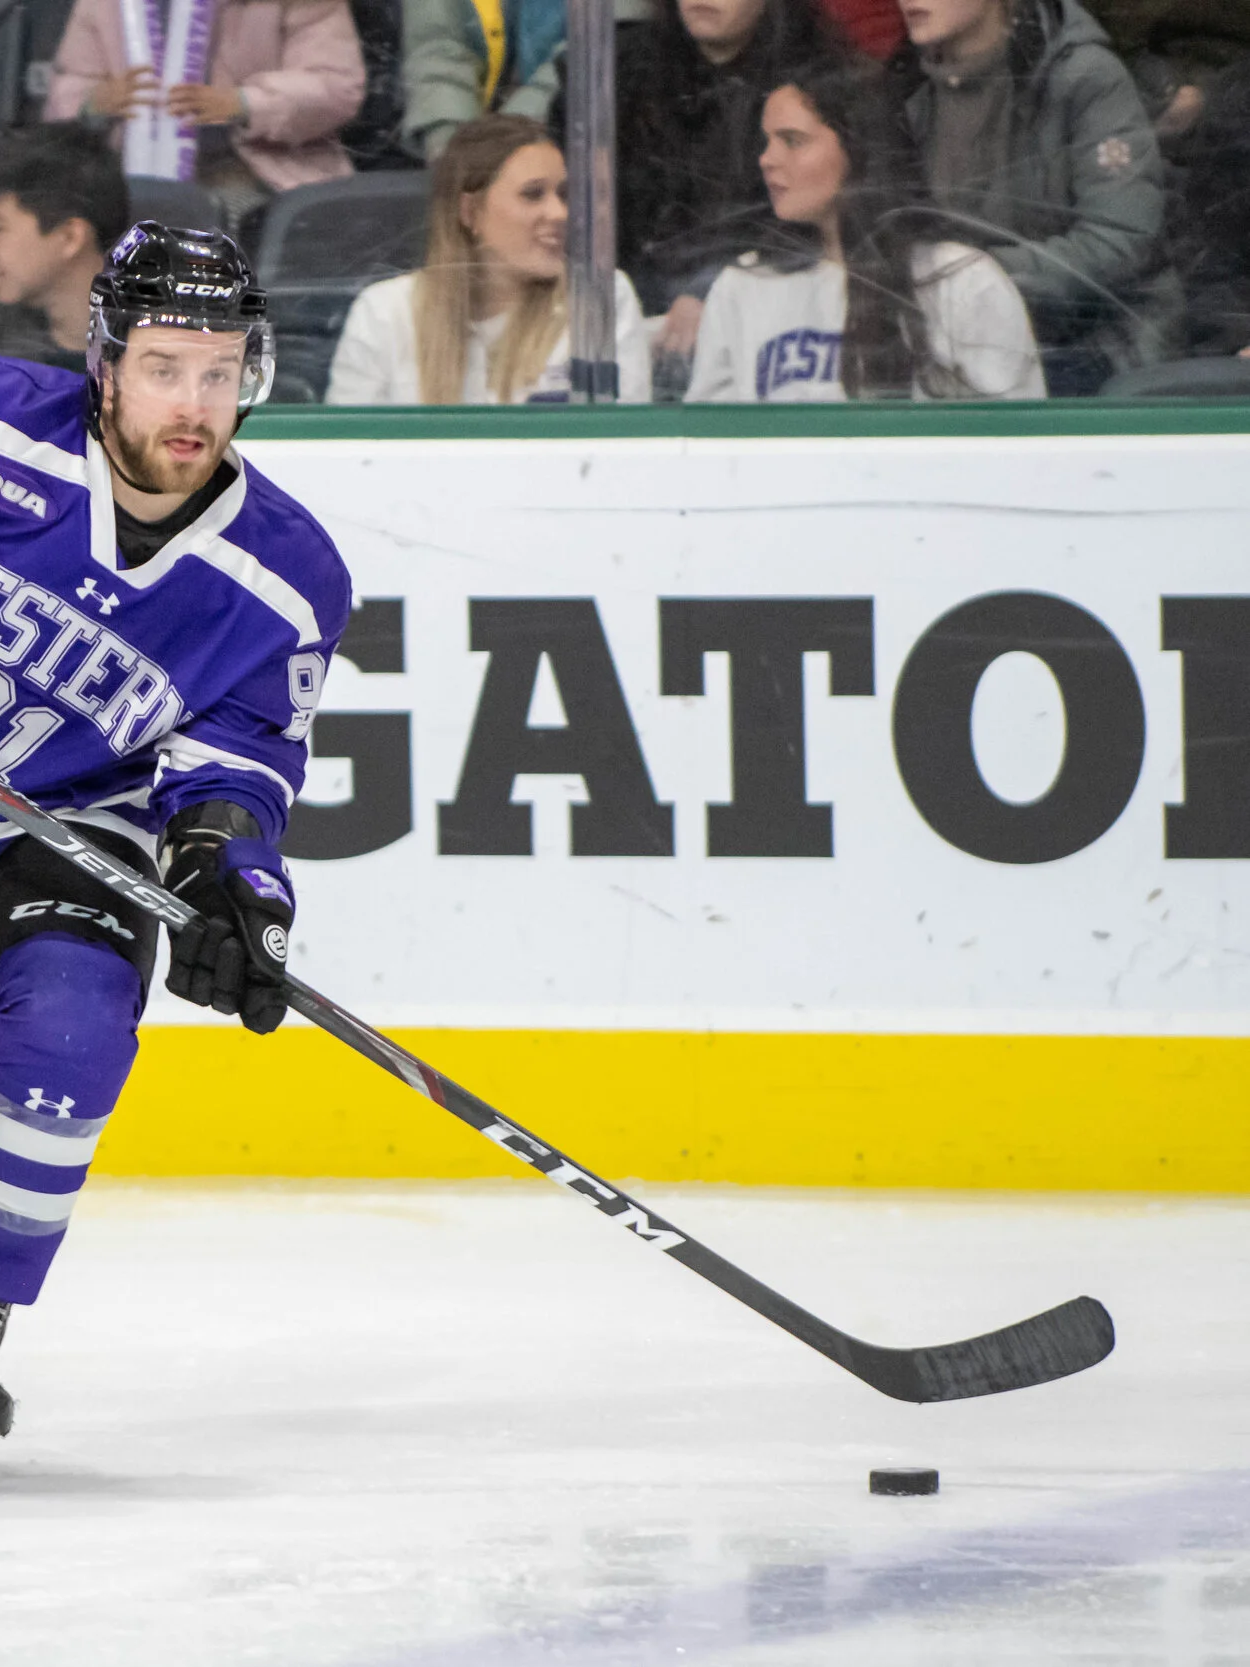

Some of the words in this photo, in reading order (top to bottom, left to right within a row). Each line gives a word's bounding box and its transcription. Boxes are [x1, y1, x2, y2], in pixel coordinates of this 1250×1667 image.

[175, 282, 233, 298] CCM
[8, 900, 136, 941] CCM
[482, 1115, 686, 1252] CCM
